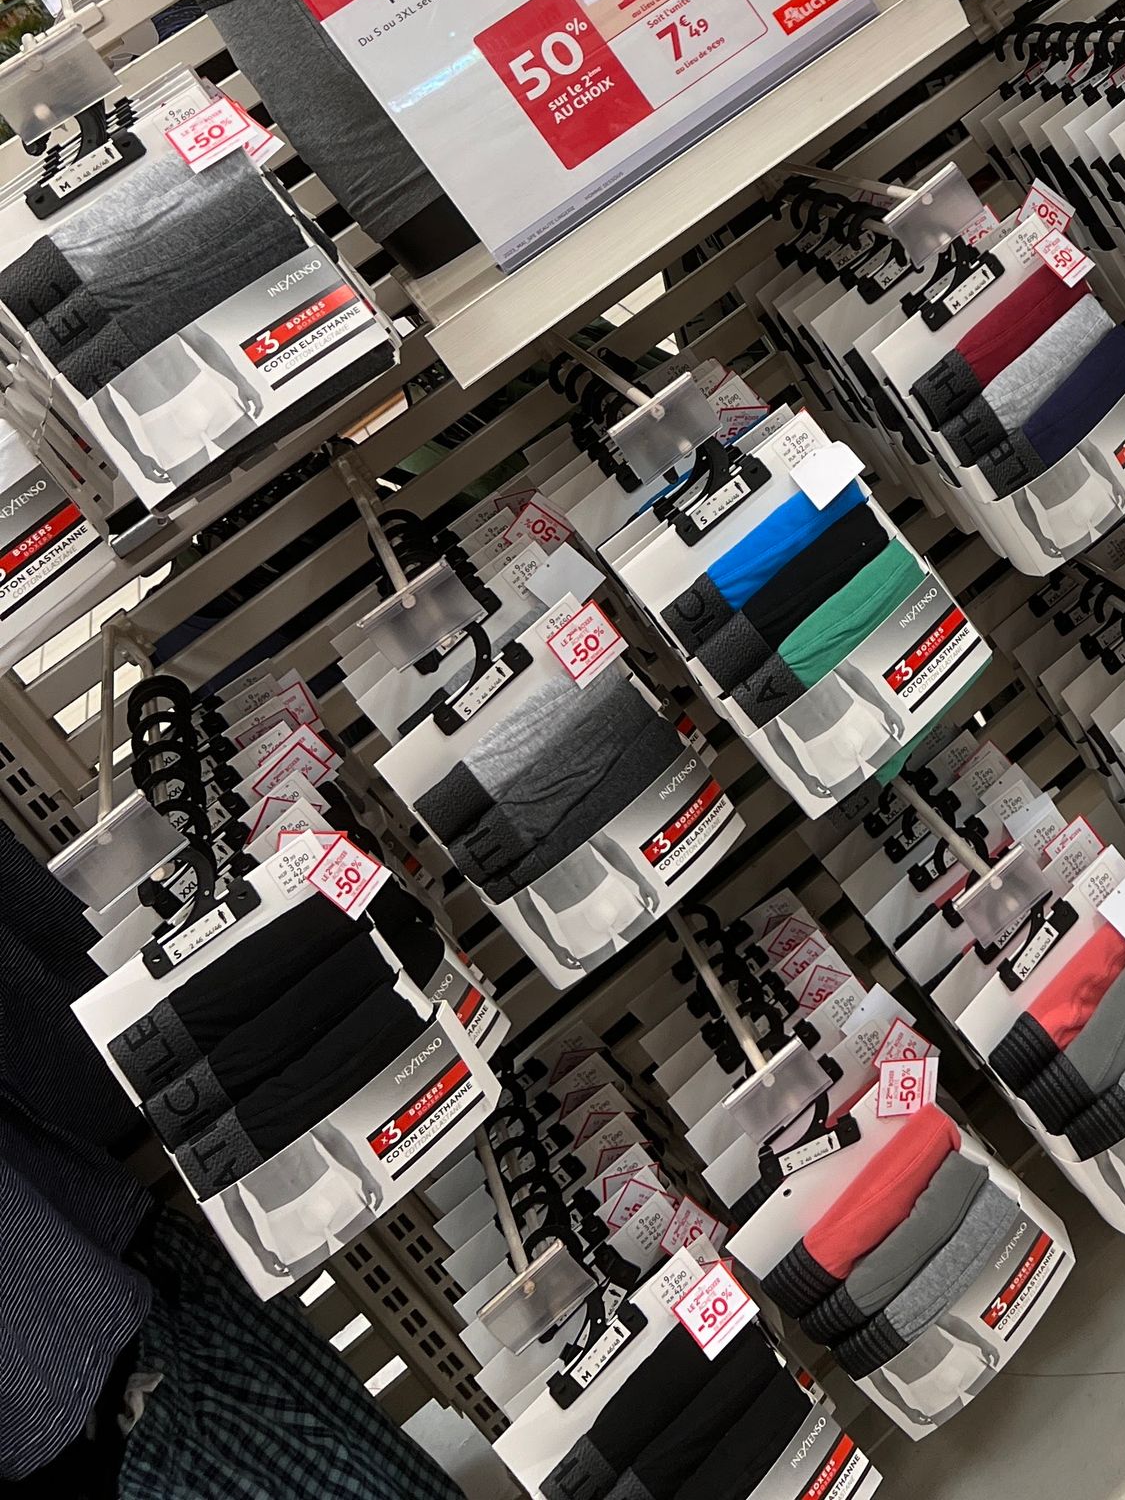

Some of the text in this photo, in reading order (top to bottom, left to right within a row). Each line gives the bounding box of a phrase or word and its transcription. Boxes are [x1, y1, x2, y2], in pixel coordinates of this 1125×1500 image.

[357, 31, 375, 47] Du
[373, 26, 382, 37] S
[394, 4, 417, 23] 3XL
[645, 12, 665, 29] Soit
[654, 21, 693, 63] 7
[685, 16, 711, 40] 49
[683, 54, 700, 69] lieu
[697, 48, 709, 59] de
[546, 91, 570, 111] sur
[566, 80, 584, 97] le
[551, 75, 616, 124] AU CHOIX
[58, 180, 71, 192] M
[284, 299, 327, 330] BOXERS
[261, 304, 361, 374] COTON ELASTHANNE
[10, 521, 53, 558] BOXERS
[25, 522, 89, 579] ELASTHANNE
[914, 625, 945, 657] BOXERS
[900, 624, 971, 699] COTON ELASTHANNE
[674, 797, 704, 829] BOXERS
[656, 796, 728, 872] COTON ELASTHANNE
[172, 948, 182, 959] S
[407, 1079, 444, 1117] BOXERS
[384, 1078, 473, 1166] COTON ELASTHANNE
[995, 1246, 1058, 1331] COTON ELASTHANNE
